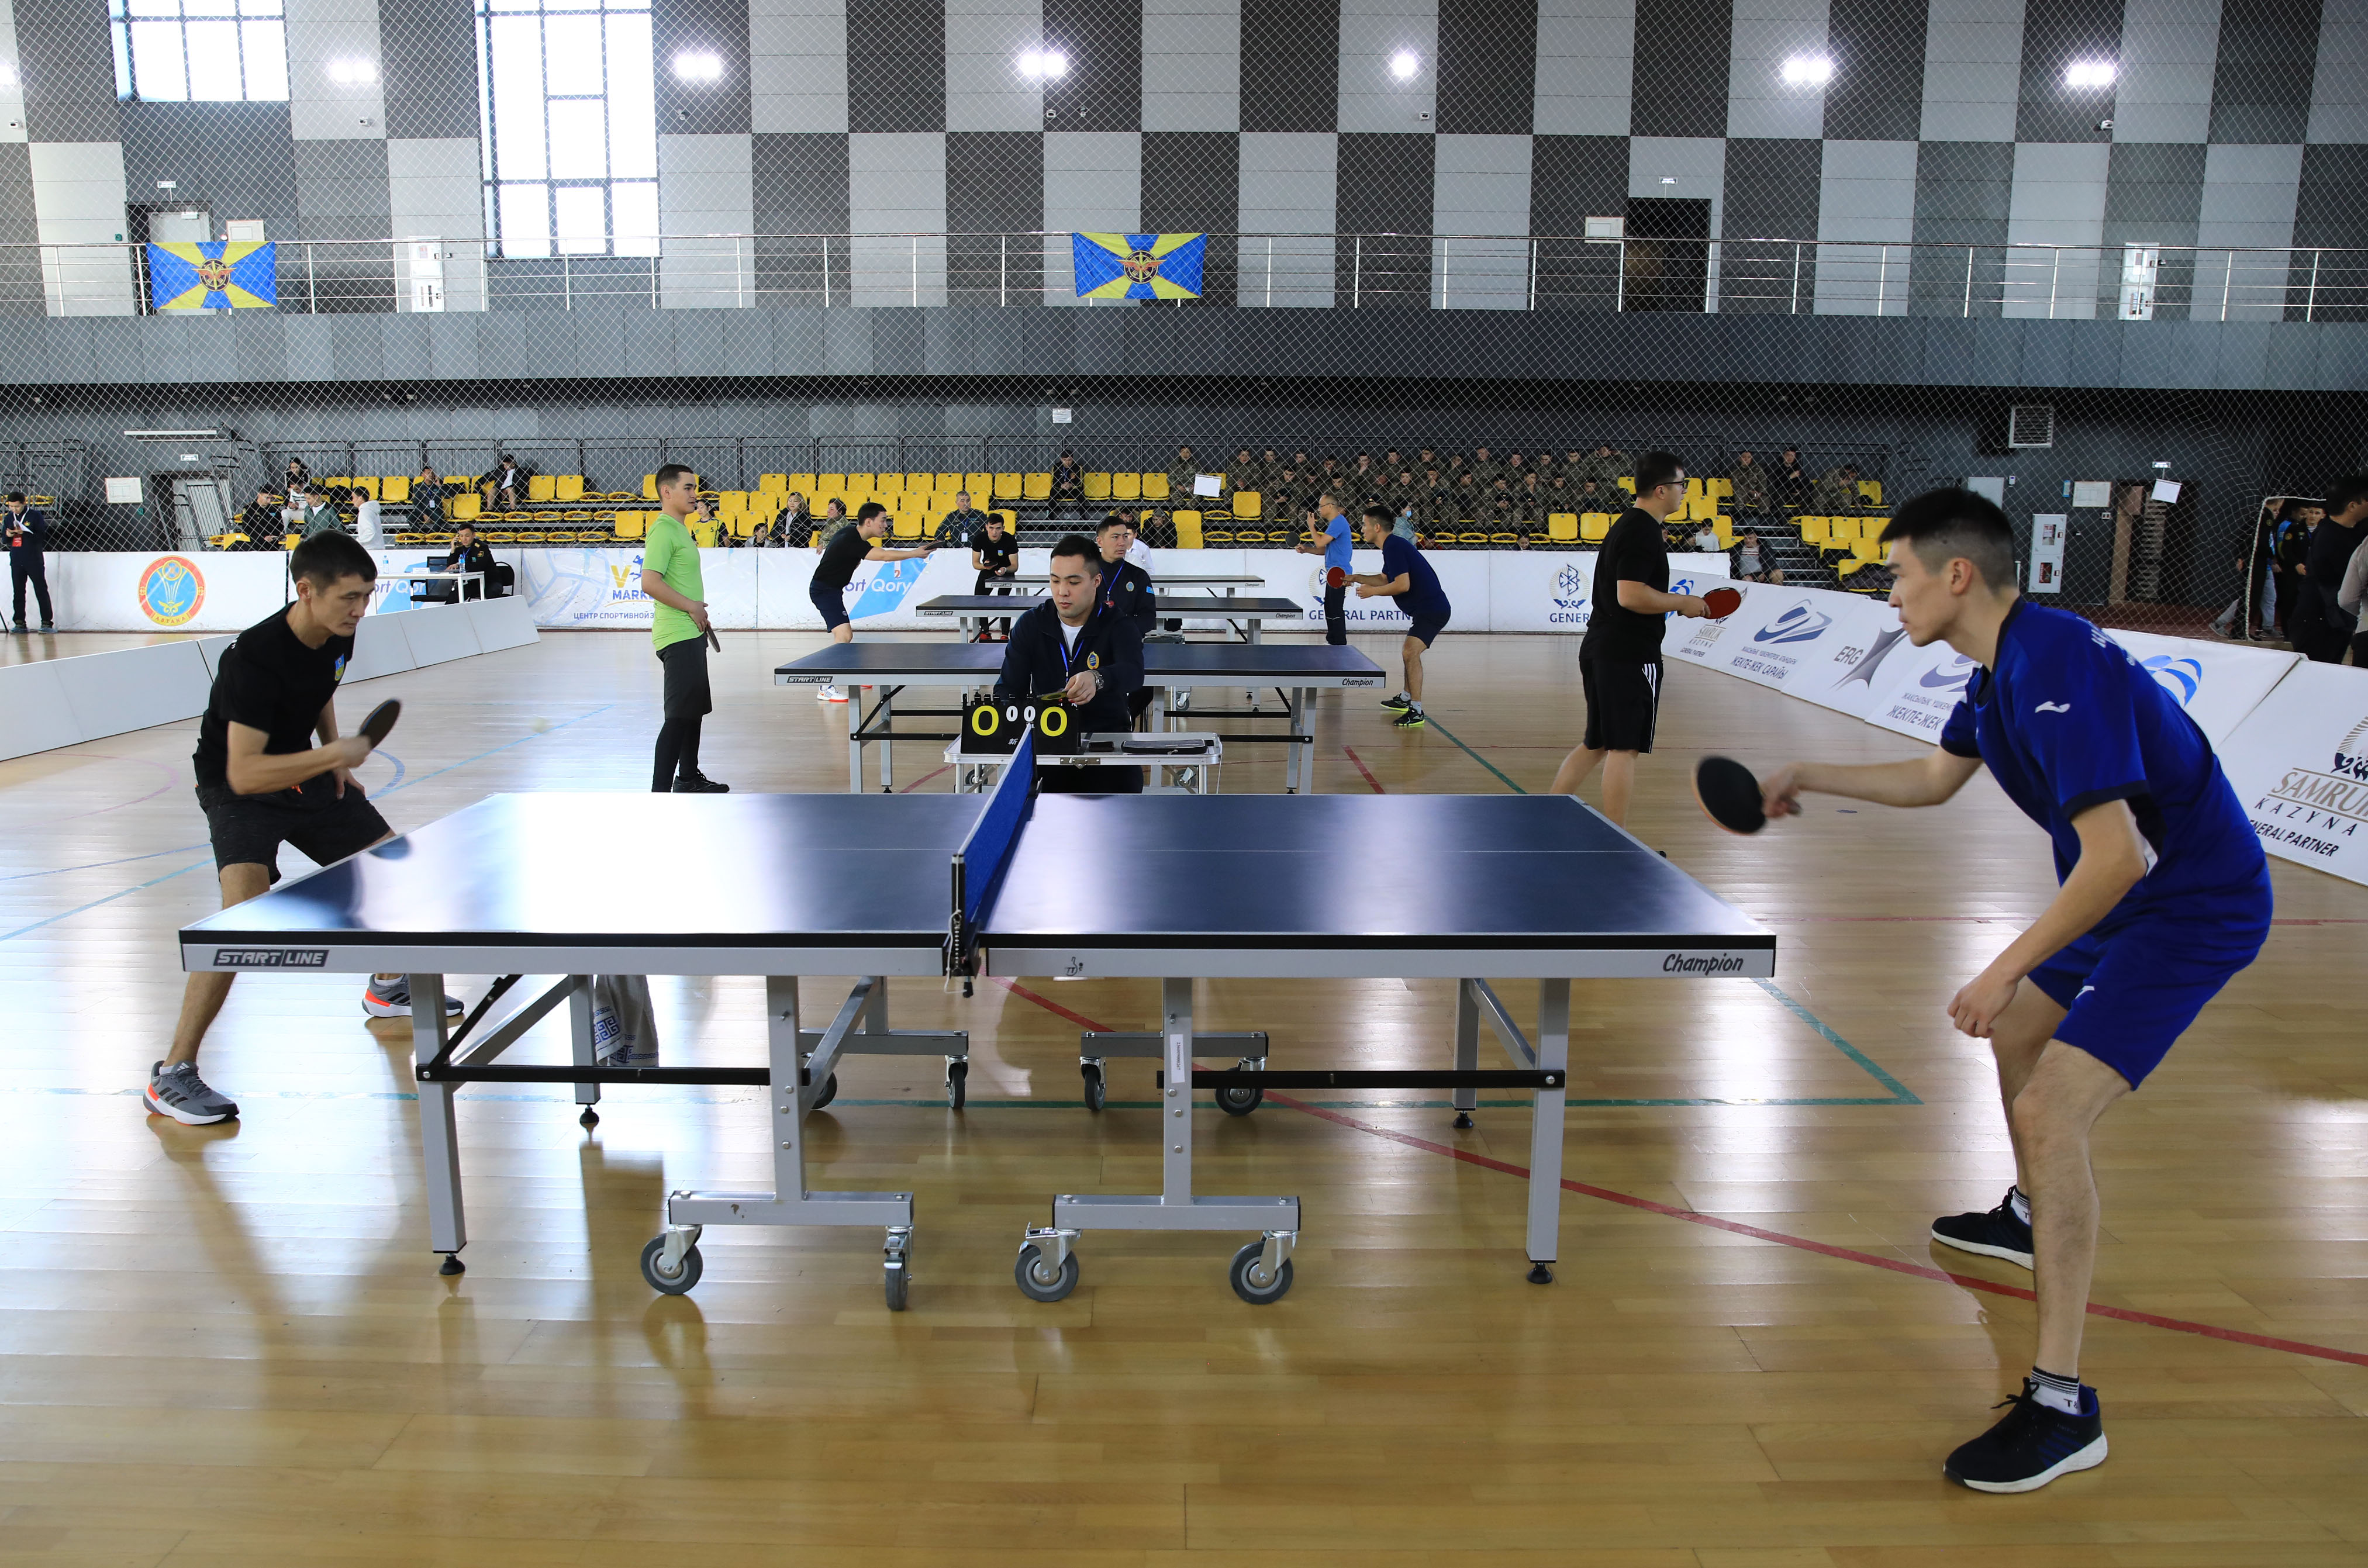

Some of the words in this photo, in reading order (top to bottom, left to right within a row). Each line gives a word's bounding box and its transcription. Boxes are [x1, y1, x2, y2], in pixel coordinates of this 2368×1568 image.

[871, 578, 913, 595] Qory
[155, 616, 187, 624] ASTANA
[599, 610, 649, 619] СПОРТИВНОЙ
[1834, 645, 1863, 665] ERG
[1731, 656, 1765, 672] ЖЕКПЕ-ЖЕК
[1762, 665, 1789, 679] САРАЙЫ
[1342, 678, 1373, 688] Champion
[1006, 706, 1019, 722] 0
[1023, 706, 1036, 722] 0
[1886, 705, 1945, 730] ЖЕКПЕ-ЖЕК
[2255, 797, 2357, 836] KAZYNA
[2283, 831, 2339, 857] PARTNER
[218, 951, 281, 965] START
[284, 952, 324, 964] LINE
[1663, 953, 1744, 976] Champion
